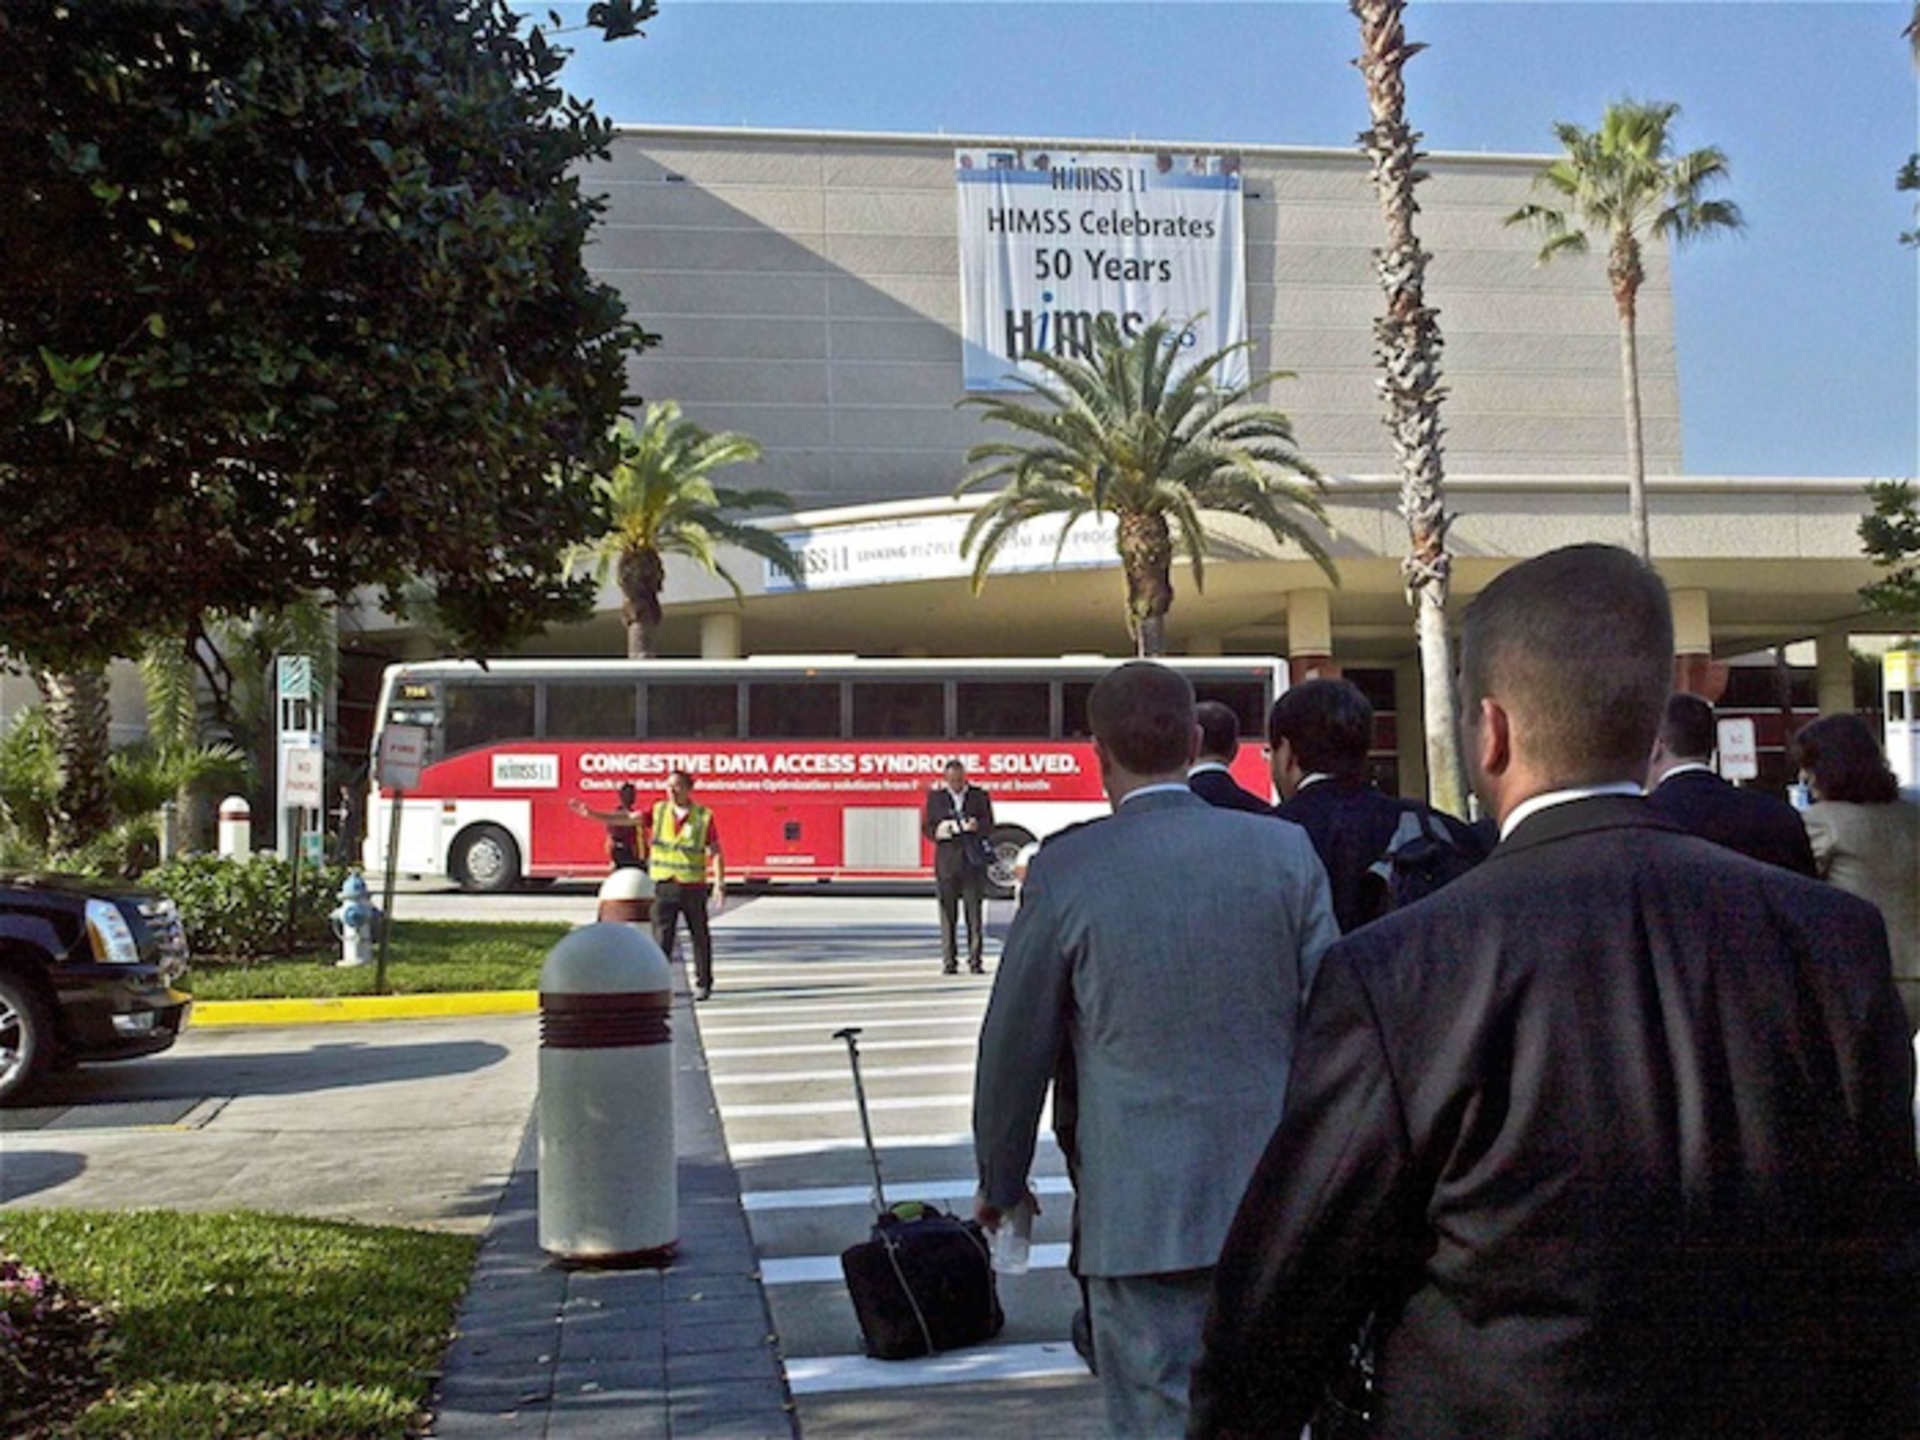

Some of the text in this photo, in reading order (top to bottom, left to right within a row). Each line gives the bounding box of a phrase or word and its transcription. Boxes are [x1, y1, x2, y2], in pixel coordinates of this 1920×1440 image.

[987, 208, 1216, 238] HIMSS Celebrates
[1035, 249, 1172, 283] 50 Years
[580, 753, 712, 773] CONGESTIVE
[714, 753, 769, 773] DATA
[772, 753, 856, 773] ACCESS
[989, 753, 1081, 774] SOLVED.
[580, 779, 613, 790] Check
[762, 779, 832, 793] Optimization
[833, 779, 880, 791] solutions
[881, 779, 910, 791] from
